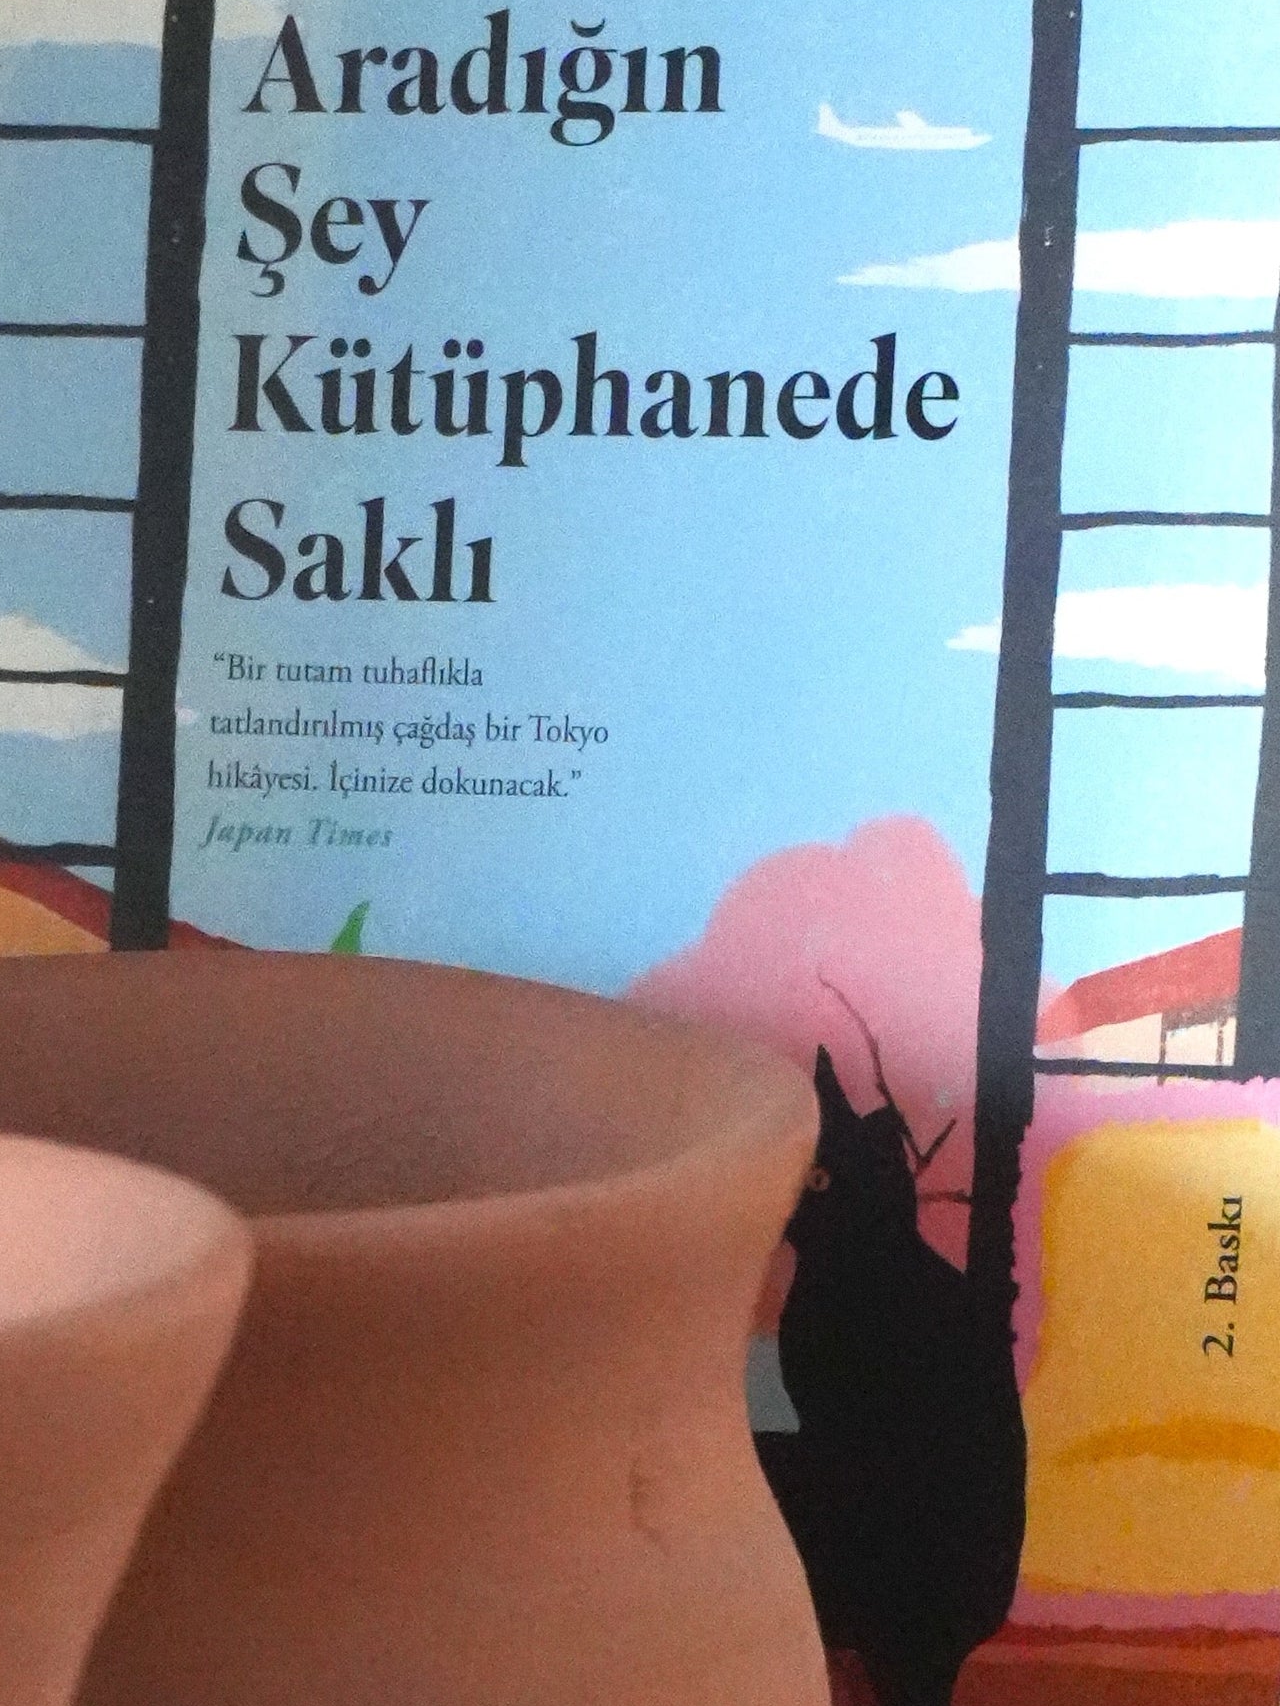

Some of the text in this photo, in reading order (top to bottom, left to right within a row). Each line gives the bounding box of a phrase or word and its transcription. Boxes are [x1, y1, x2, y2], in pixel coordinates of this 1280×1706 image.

[241, 8, 725, 147] Aradığın
[237, 163, 429, 297] Şey
[229, 332, 959, 467] Kütüphanede
[221, 497, 495, 602] Saklı
[277, 664, 352, 683] tutam
[363, 656, 483, 686] tuhaflıkla
[208, 760, 319, 798] hikâyesi.
[330, 757, 412, 799] İçinize
[211, 707, 609, 752] tatlandırılmış çağdaş bir Tokyo
[199, 816, 392, 852] Japan Times
[1202, 1195, 1242, 1357] 2. Baskı
